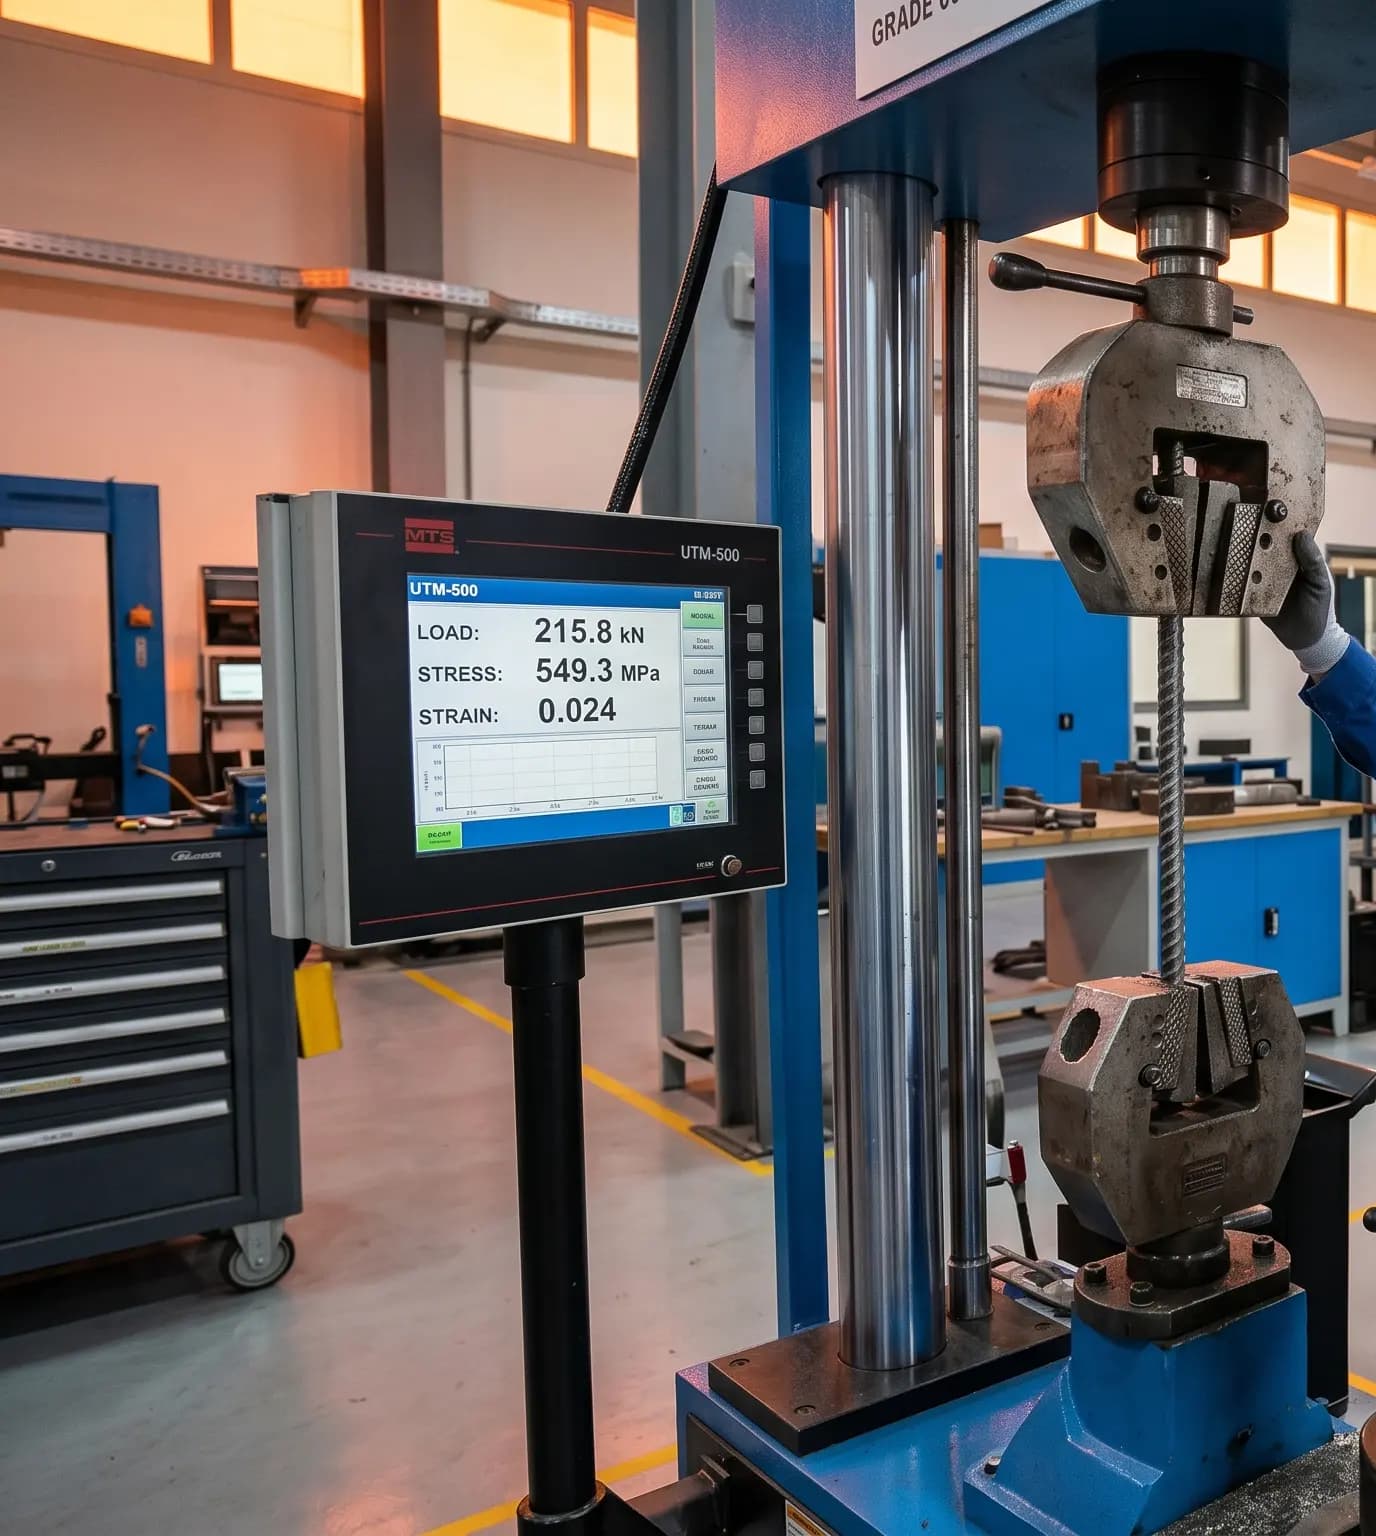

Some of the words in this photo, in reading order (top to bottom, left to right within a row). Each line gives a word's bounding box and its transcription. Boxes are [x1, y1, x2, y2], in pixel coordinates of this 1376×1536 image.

[872, 0, 933, 46] GRADE
[404, 528, 455, 544] MTS
[681, 544, 740, 562] UTM-500
[409, 581, 478, 597] UTM-500
[417, 624, 479, 640] LOAD:
[535, 617, 612, 644] 215.8
[620, 626, 645, 644] kN
[418, 665, 502, 682] STRESS:
[536, 657, 613, 683] 549.3
[621, 664, 660, 682] MPa
[419, 707, 499, 725] STRAIN:
[538, 697, 616, 723] 0.024
